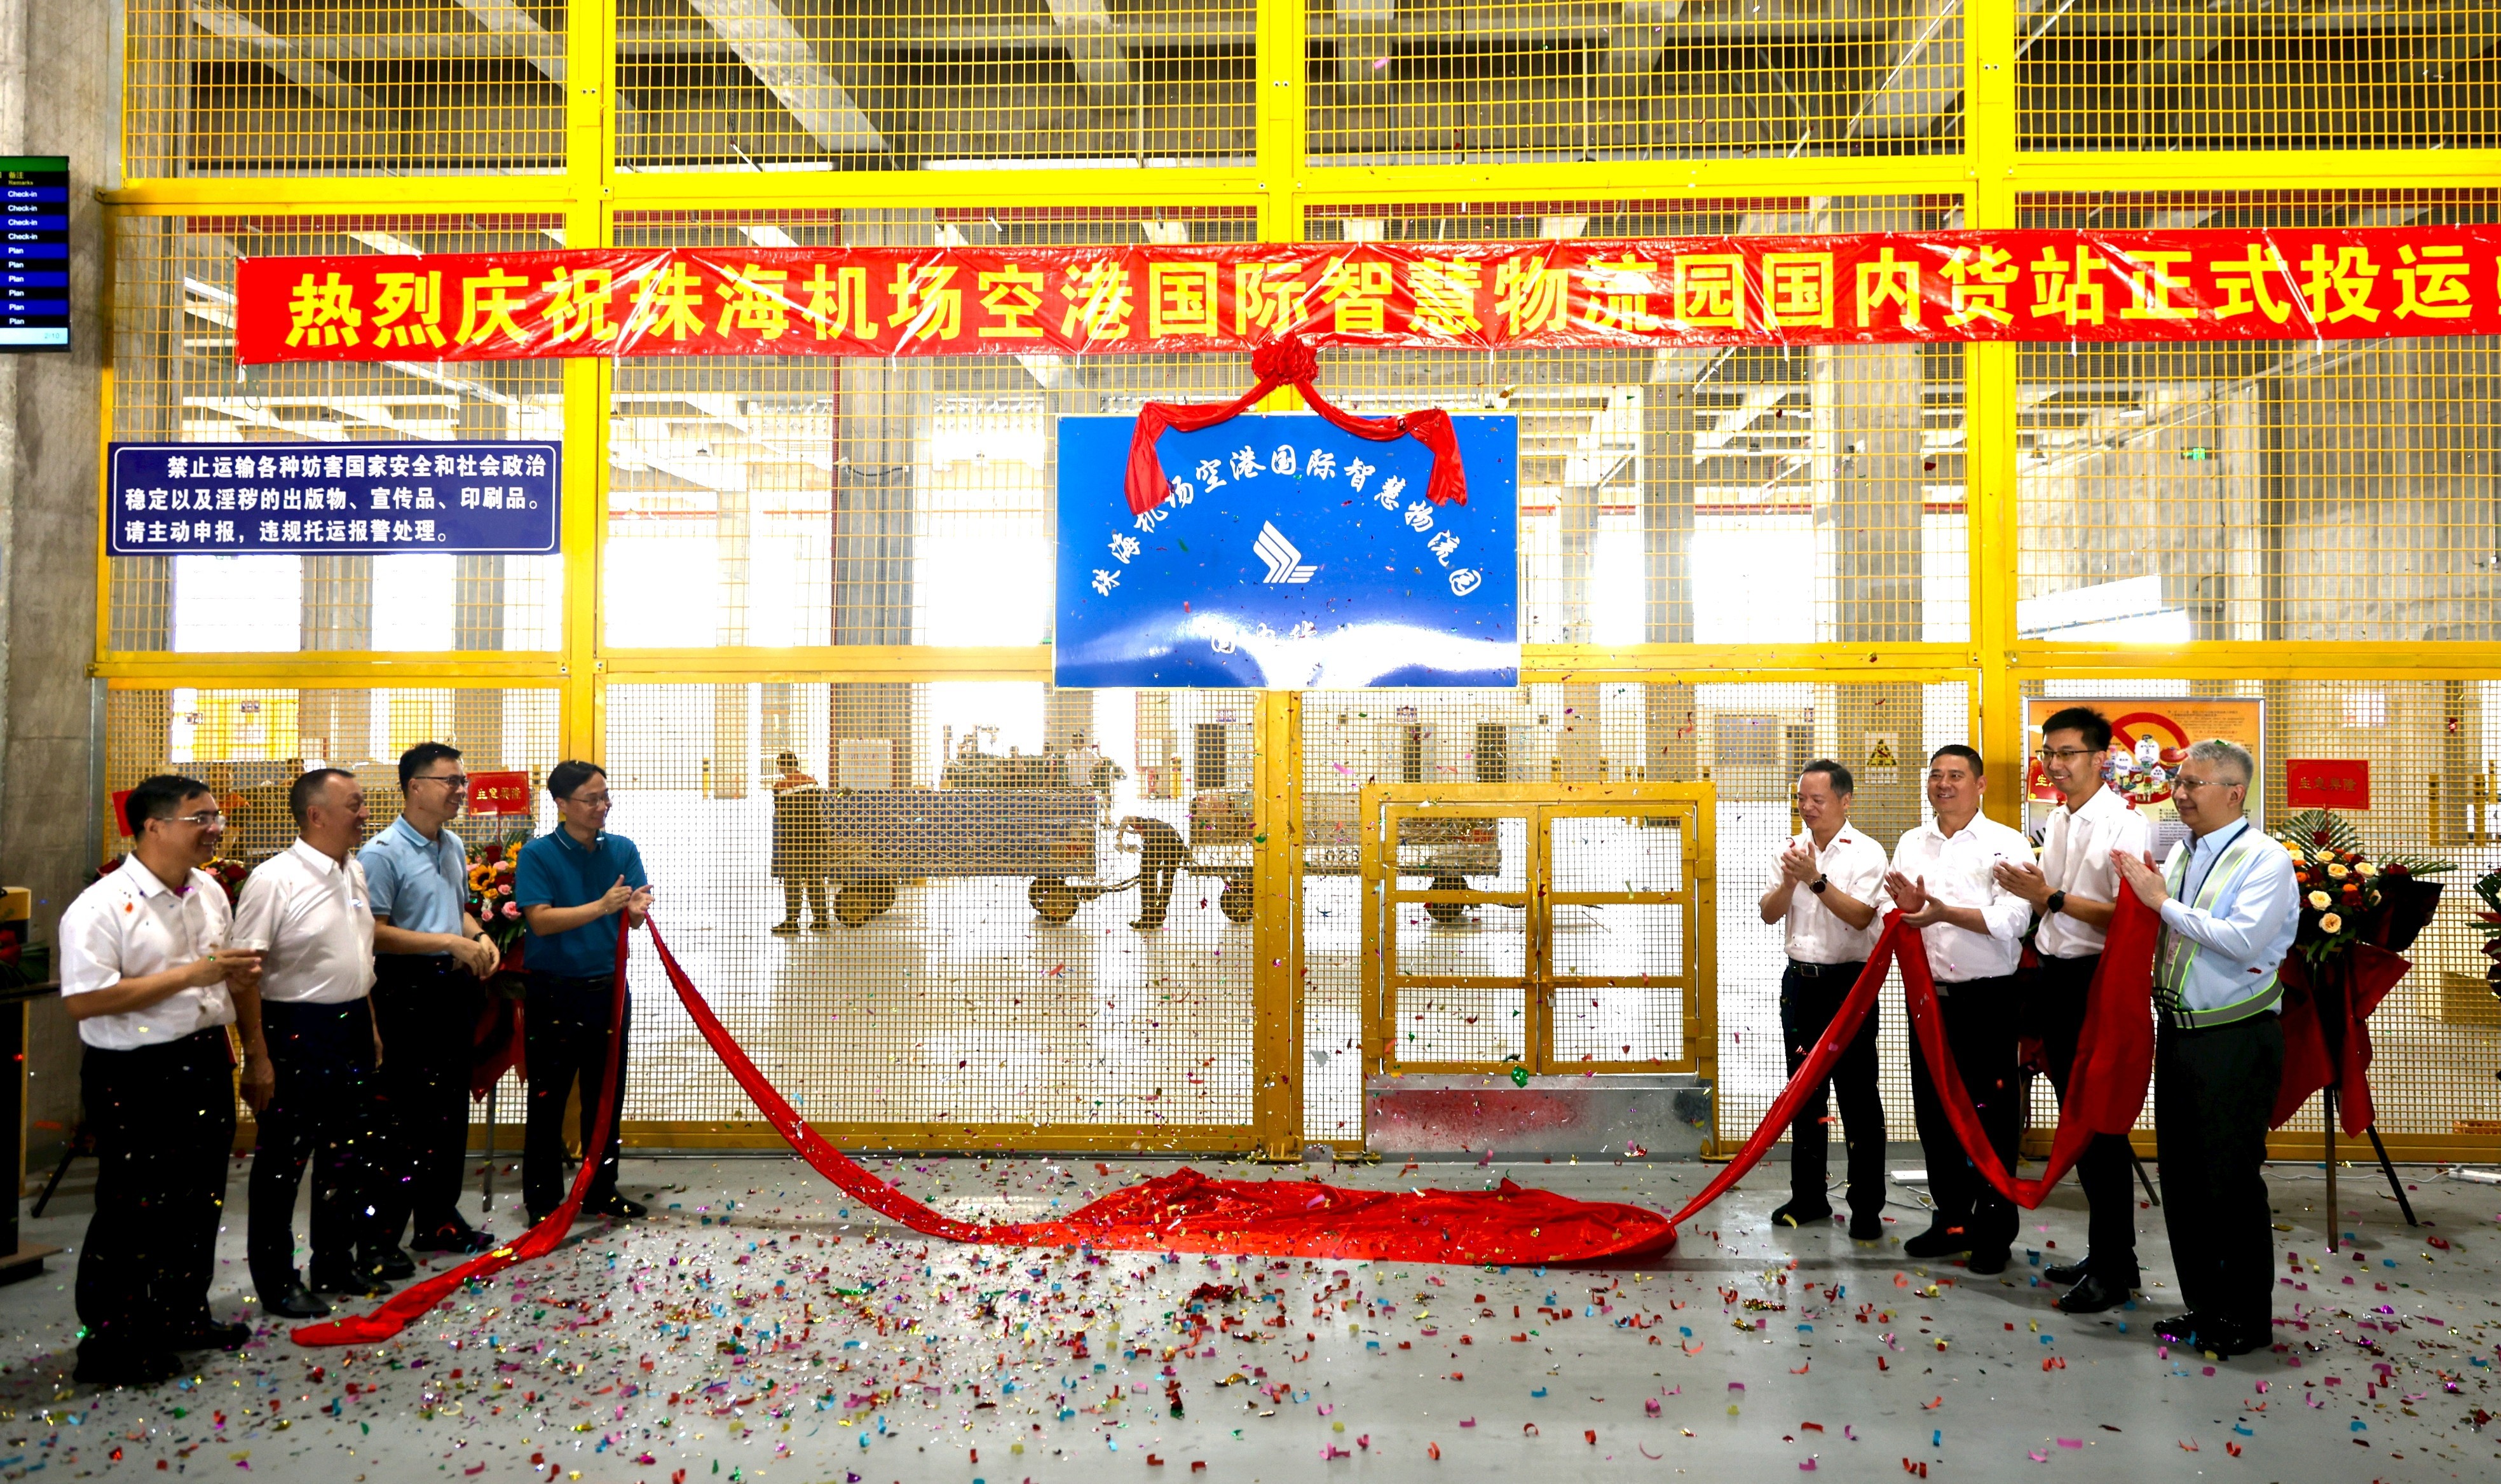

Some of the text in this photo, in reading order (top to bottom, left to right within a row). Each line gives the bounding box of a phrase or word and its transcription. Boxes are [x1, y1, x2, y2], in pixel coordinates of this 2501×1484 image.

[168, 454, 547, 479] 禁止运输各种妨害国家安全和社会政治
[125, 486, 538, 511] 稳定以及淫秽的出版物、宣传品、印刷品。
[124, 519, 447, 543] 请主动申报，违规托运报警处理。
